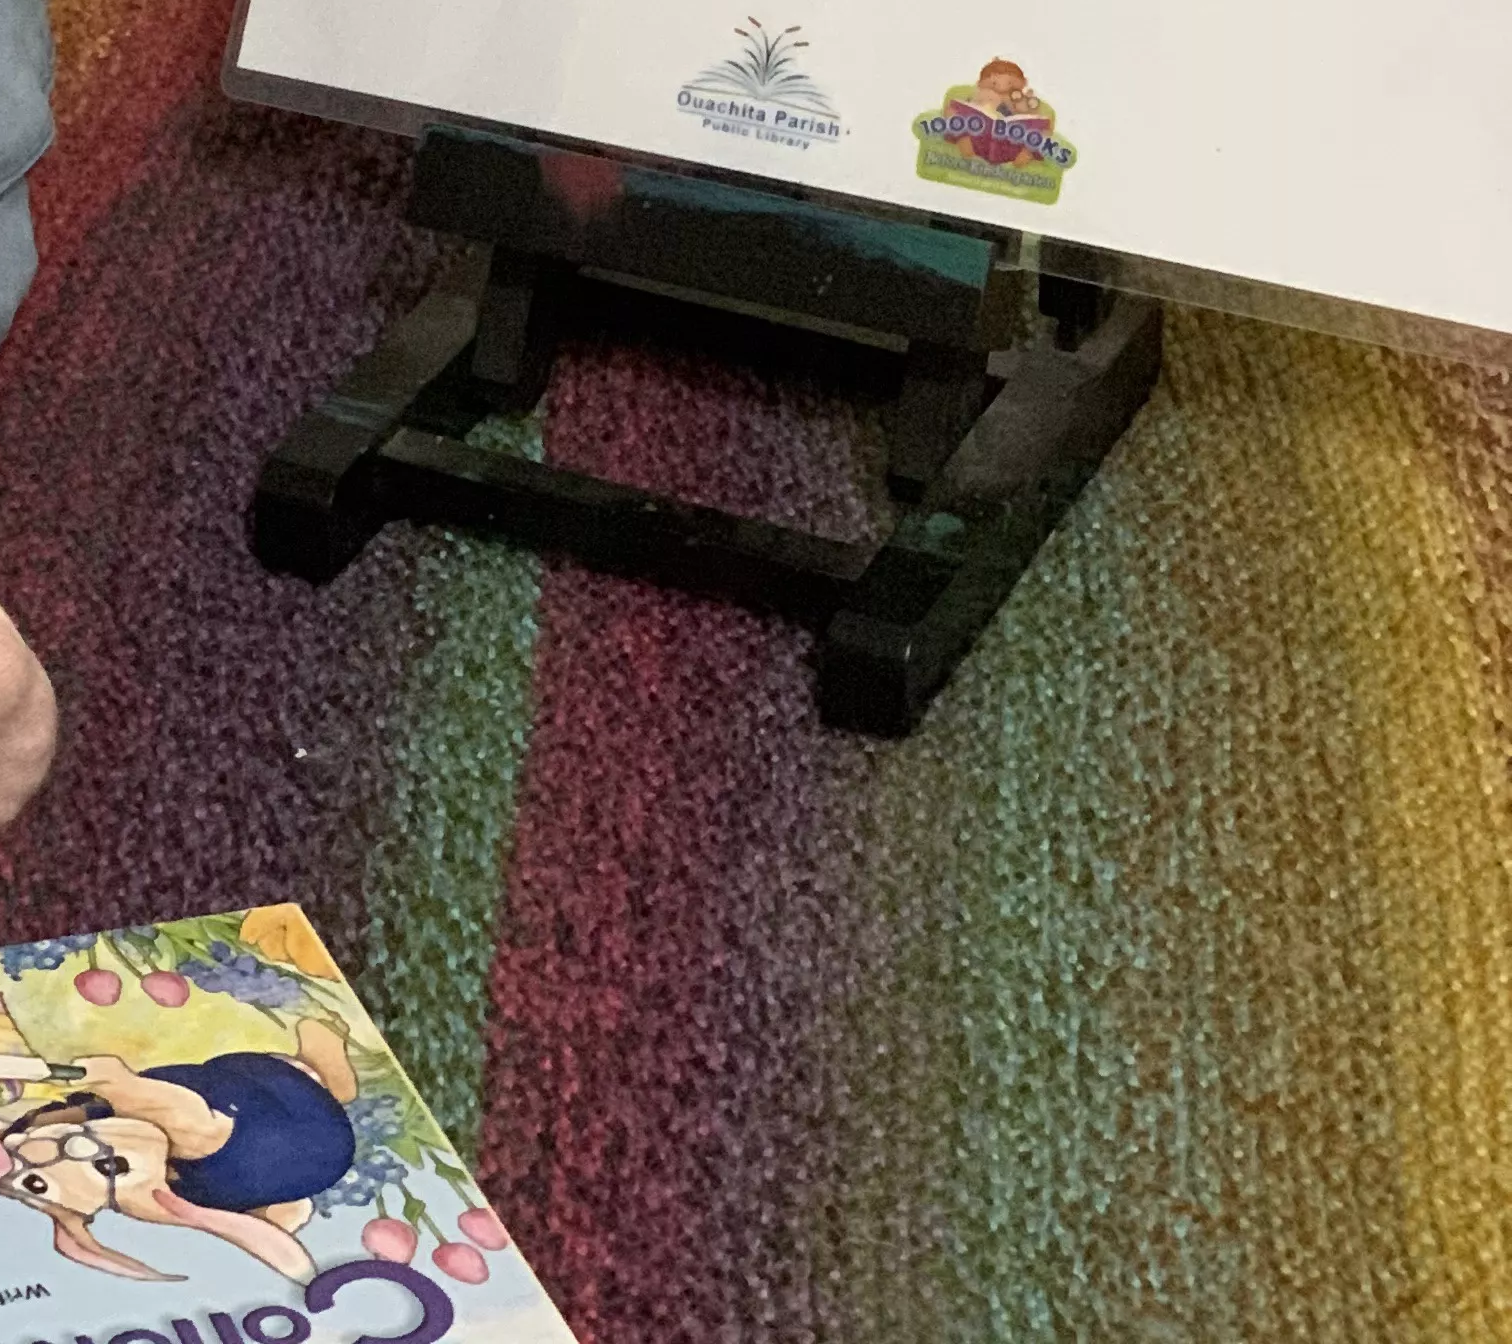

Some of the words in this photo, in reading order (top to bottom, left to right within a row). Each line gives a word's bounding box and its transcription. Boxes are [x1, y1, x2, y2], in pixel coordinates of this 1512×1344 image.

[676, 90, 767, 123] Ouachita
[774, 110, 840, 138] Parish
[701, 118, 750, 138] Public
[755, 128, 811, 151] Library
[919, 115, 985, 136] 1000
[993, 119, 1073, 164] BOOKS
